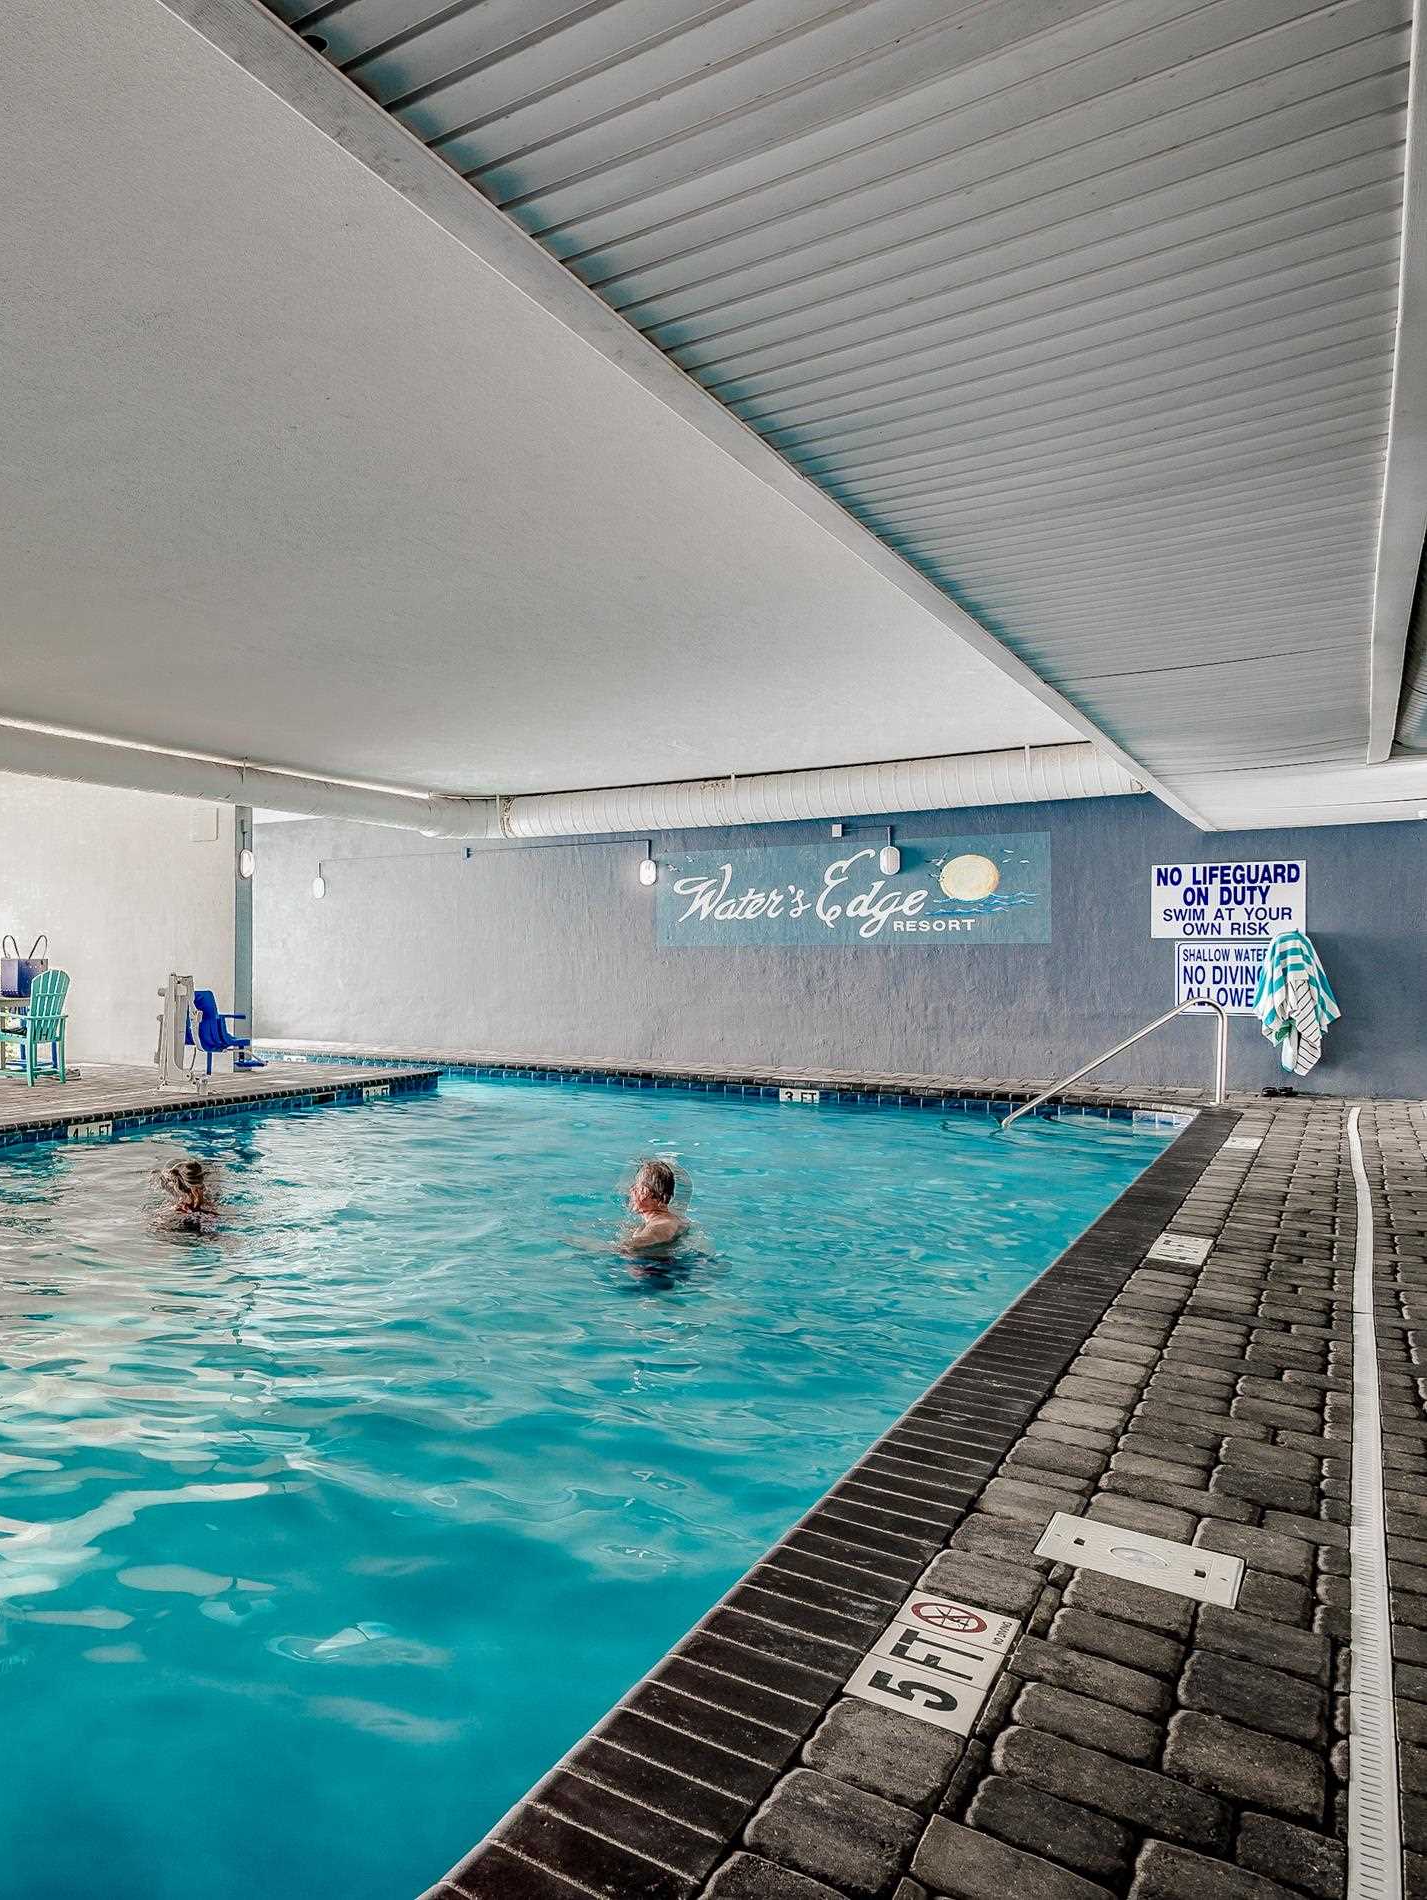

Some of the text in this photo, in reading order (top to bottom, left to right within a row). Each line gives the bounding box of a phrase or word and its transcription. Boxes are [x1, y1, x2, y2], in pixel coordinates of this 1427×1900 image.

[1156, 863, 1300, 886] NO LIFEGUARD
[673, 849, 929, 938] Water's Edge
[1183, 885, 1270, 906] ON DUTY
[1163, 907, 1292, 922] SWIM AT YOUR
[893, 918, 976, 933] RESORT
[1182, 922, 1270, 936] OWN RISK
[1182, 948, 1230, 962] SHALLOW
[1183, 966, 1206, 985] NO
[1186, 987, 1255, 1007] ALLOWE
[801, 1092, 817, 1103] FT
[99, 1124, 110, 1136] FT
[868, 1628, 985, 1712] 5 FT
